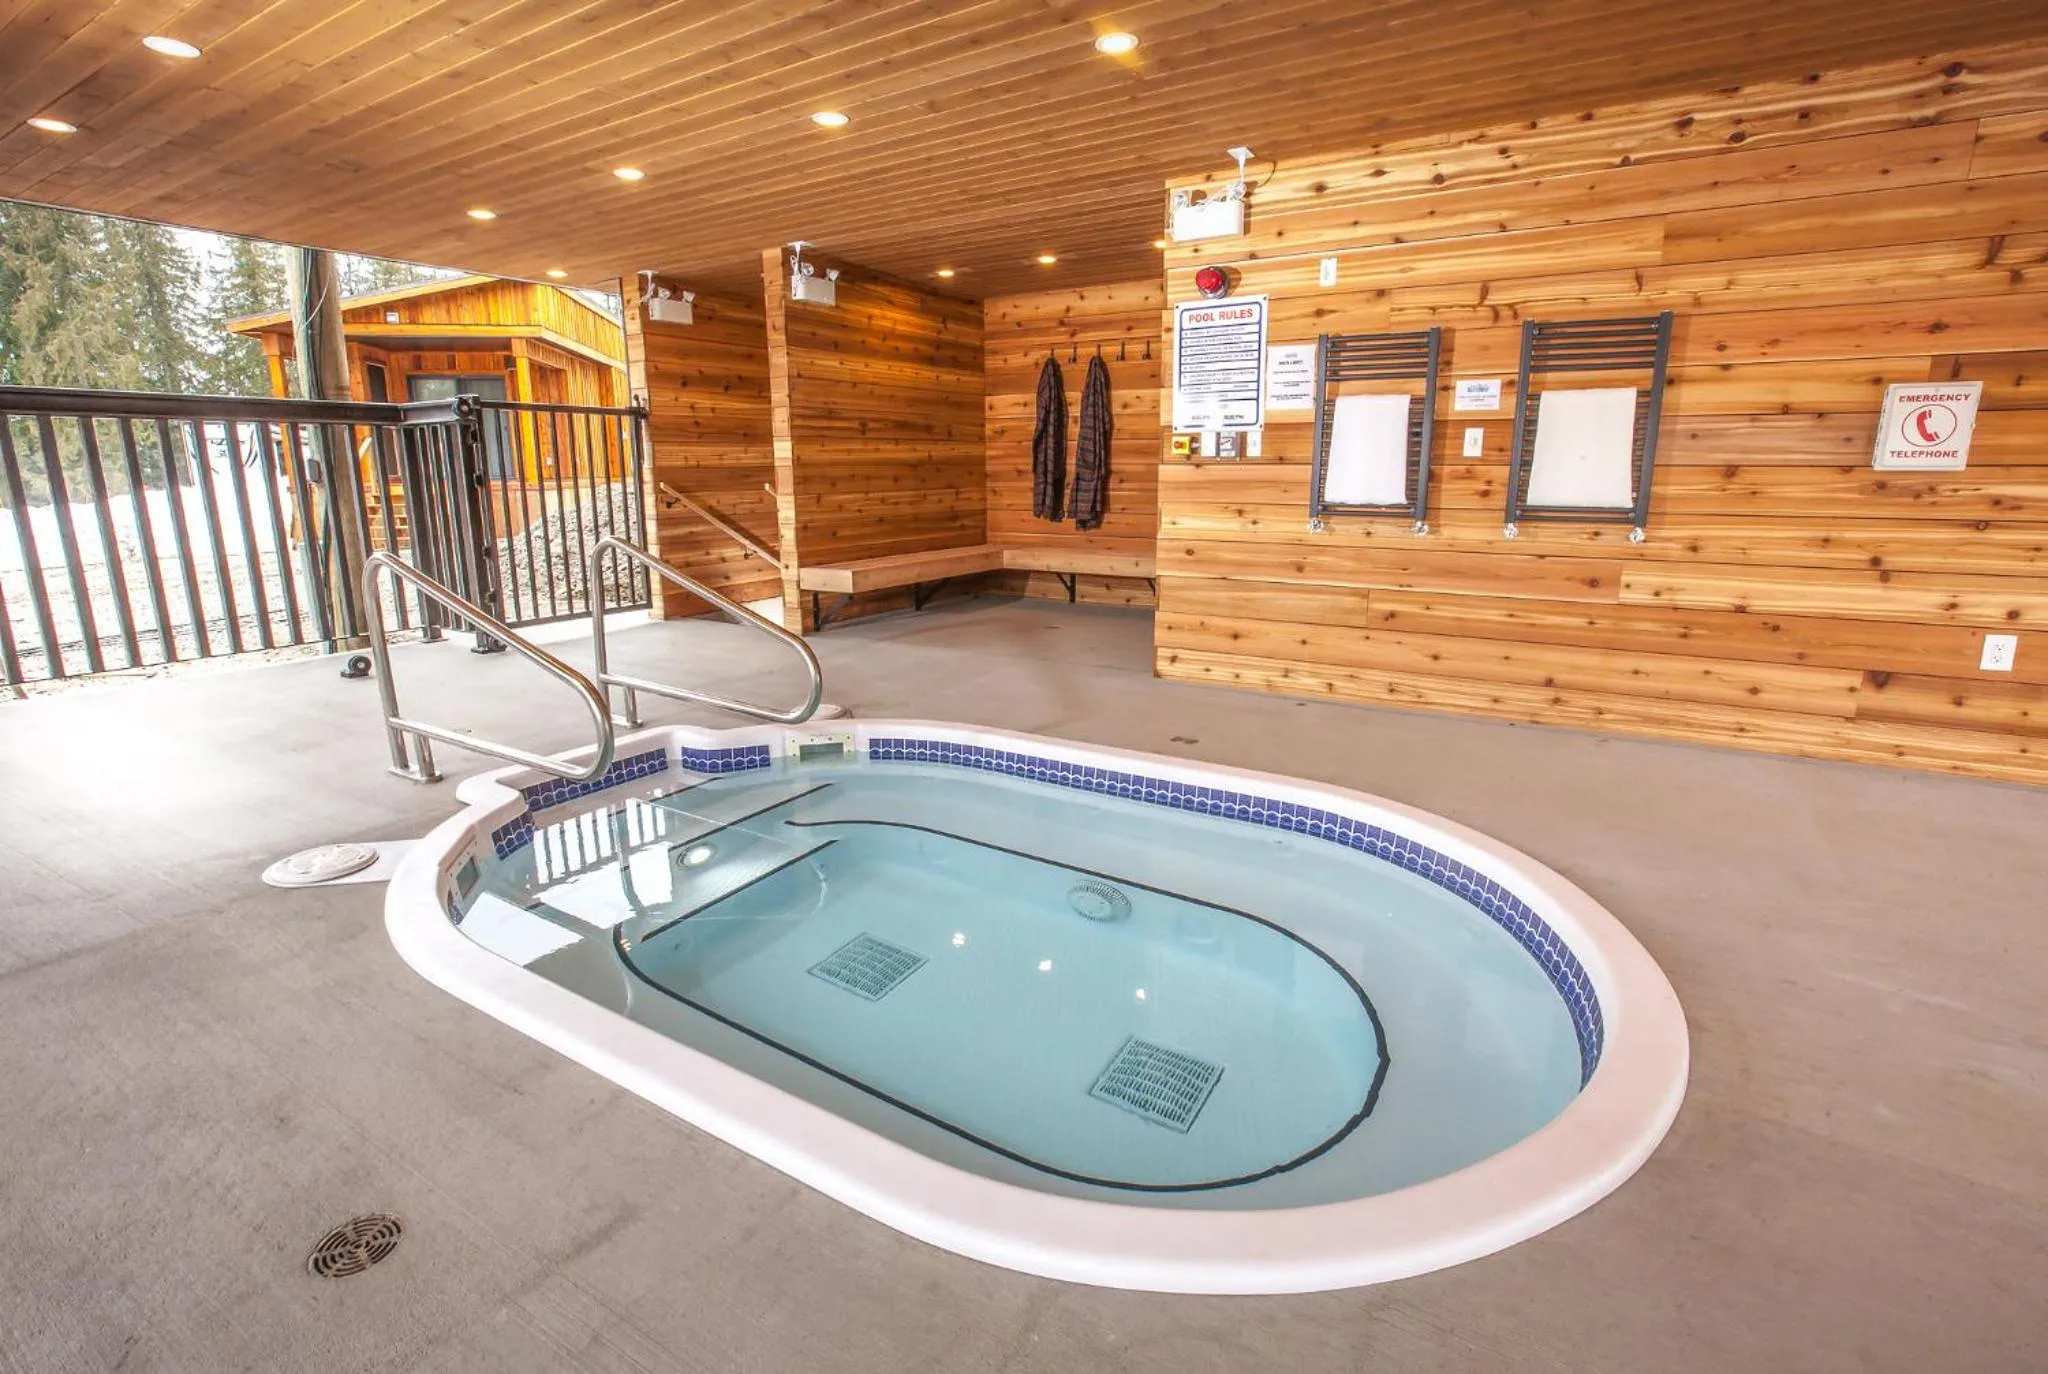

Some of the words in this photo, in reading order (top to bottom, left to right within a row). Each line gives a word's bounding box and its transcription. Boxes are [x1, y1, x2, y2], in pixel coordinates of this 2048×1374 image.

[1189, 312, 1215, 324] POOL
[1218, 309, 1253, 321] RULES
[1898, 393, 1971, 403] EMERGENCY
[1889, 450, 1959, 458] TELEPHONE
